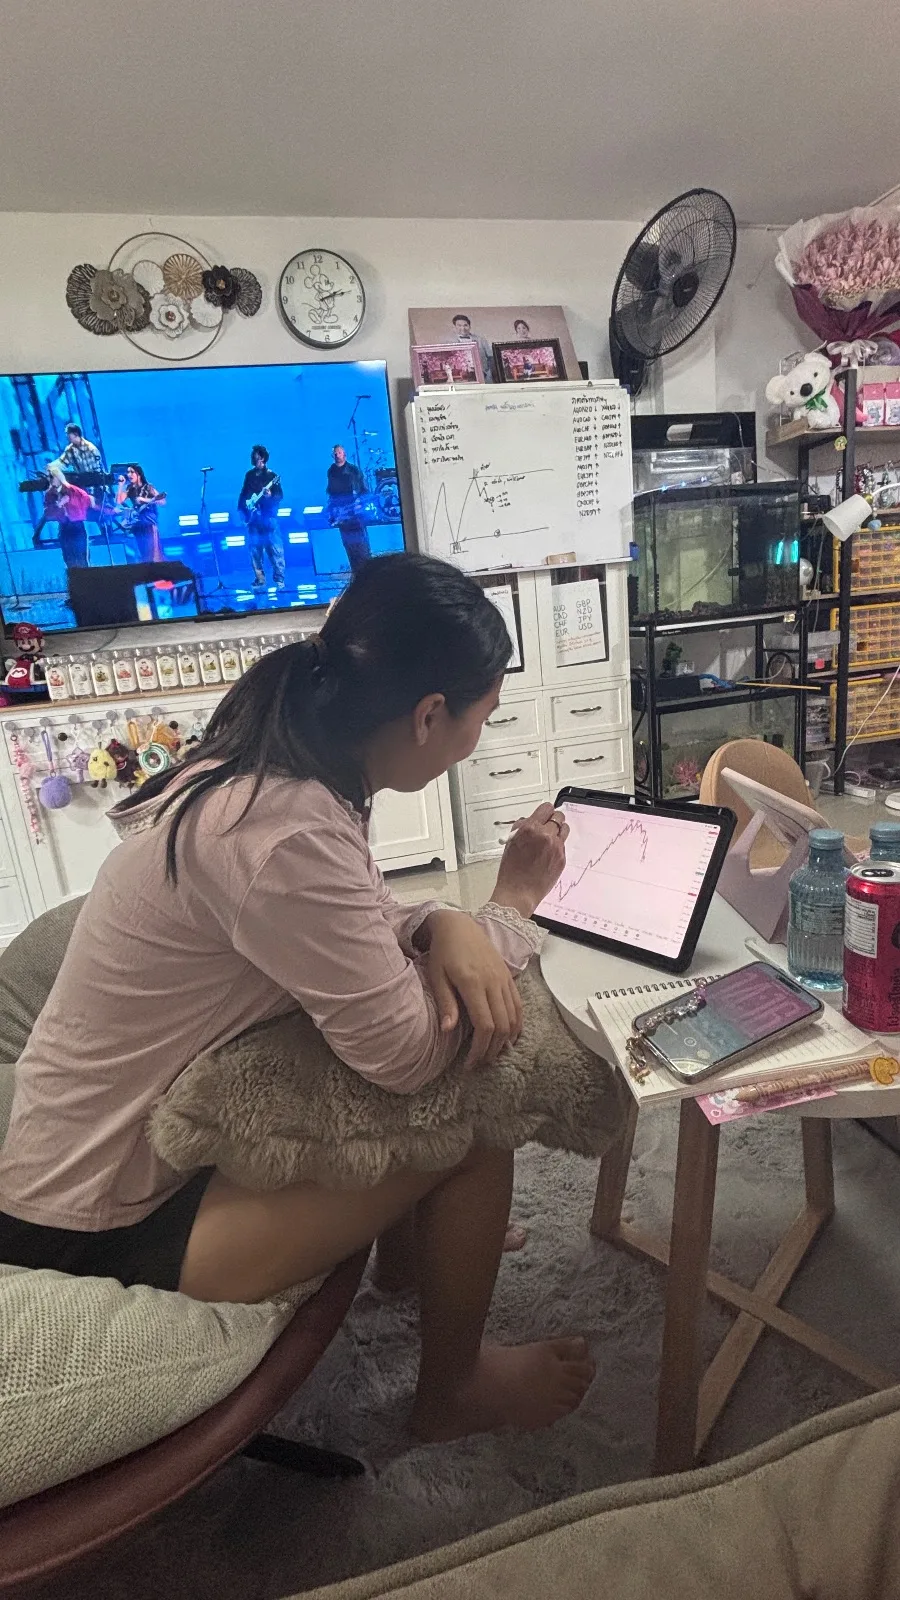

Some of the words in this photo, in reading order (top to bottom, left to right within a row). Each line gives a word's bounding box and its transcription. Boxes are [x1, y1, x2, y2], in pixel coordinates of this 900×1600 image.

[313, 255, 323, 263] 12
[285, 276, 295, 284] 10
[349, 276, 355, 284] 2
[282, 296, 288, 304] 9
[356, 295, 362, 303] 3
[290, 315, 296, 324] 8
[306, 330, 311, 338] 7
[342, 329, 348, 337] 5
[324, 334, 330, 342] 6
[576, 599, 591, 608] GBP
[553, 604, 566, 612] AUD
[577, 606, 592, 615] NZD
[578, 614, 592, 623] JPY
[578, 622, 593, 631] USD
[555, 628, 569, 637] EUR
